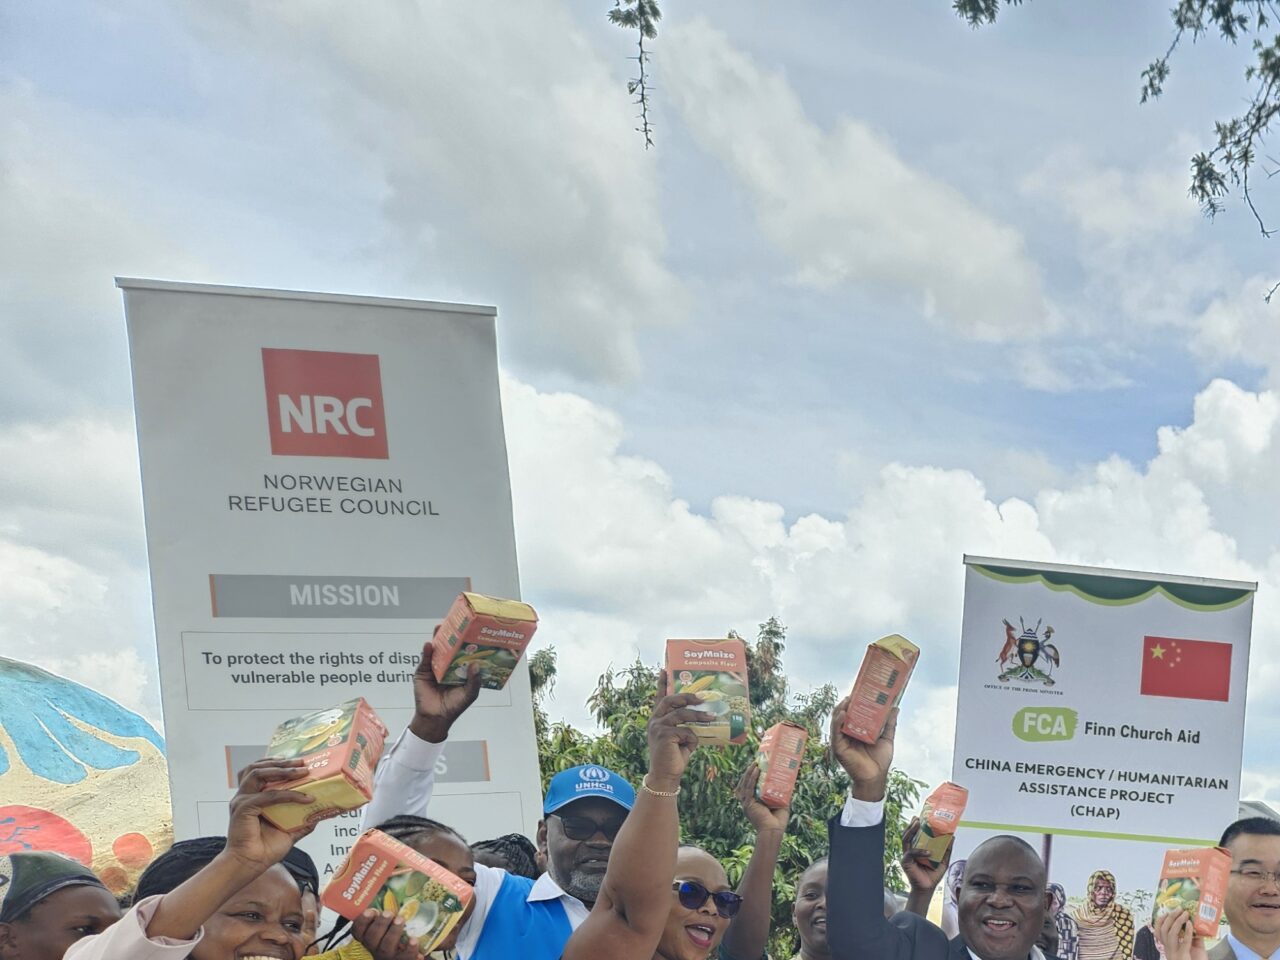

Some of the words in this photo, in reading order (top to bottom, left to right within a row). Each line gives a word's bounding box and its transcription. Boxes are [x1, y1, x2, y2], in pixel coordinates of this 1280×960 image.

[278, 394, 375, 437] NRC
[263, 473, 403, 493] NORWEGIAN
[228, 495, 332, 513] REFUGEE
[340, 498, 440, 516] COUNCIL
[289, 584, 400, 607] MISSION
[480, 626, 525, 639] SoyMaize
[202, 651, 222, 665] To
[227, 651, 288, 668] protect
[290, 651, 316, 665] the
[319, 651, 365, 668] rights
[369, 651, 385, 665] of
[683, 650, 736, 660] SoyMaize
[231, 670, 316, 684] vulnerable
[319, 672, 372, 686] people
[1023, 712, 1068, 737] FCA
[1084, 721, 1117, 738] Finn
[1120, 724, 1173, 743] Church
[1177, 728, 1201, 744] Aid
[965, 757, 1012, 773] CHINA
[1015, 761, 1106, 781] EMERGENCY
[1108, 769, 1115, 782] /
[1117, 770, 1229, 790] HUMANITARIAN
[575, 782, 614, 792] UNHCR
[1018, 781, 1107, 799] ASSISTANCE
[1110, 788, 1175, 805] PROJECT
[1070, 804, 1121, 821] (CHAP)
[342, 854, 378, 900] SoyMaize
